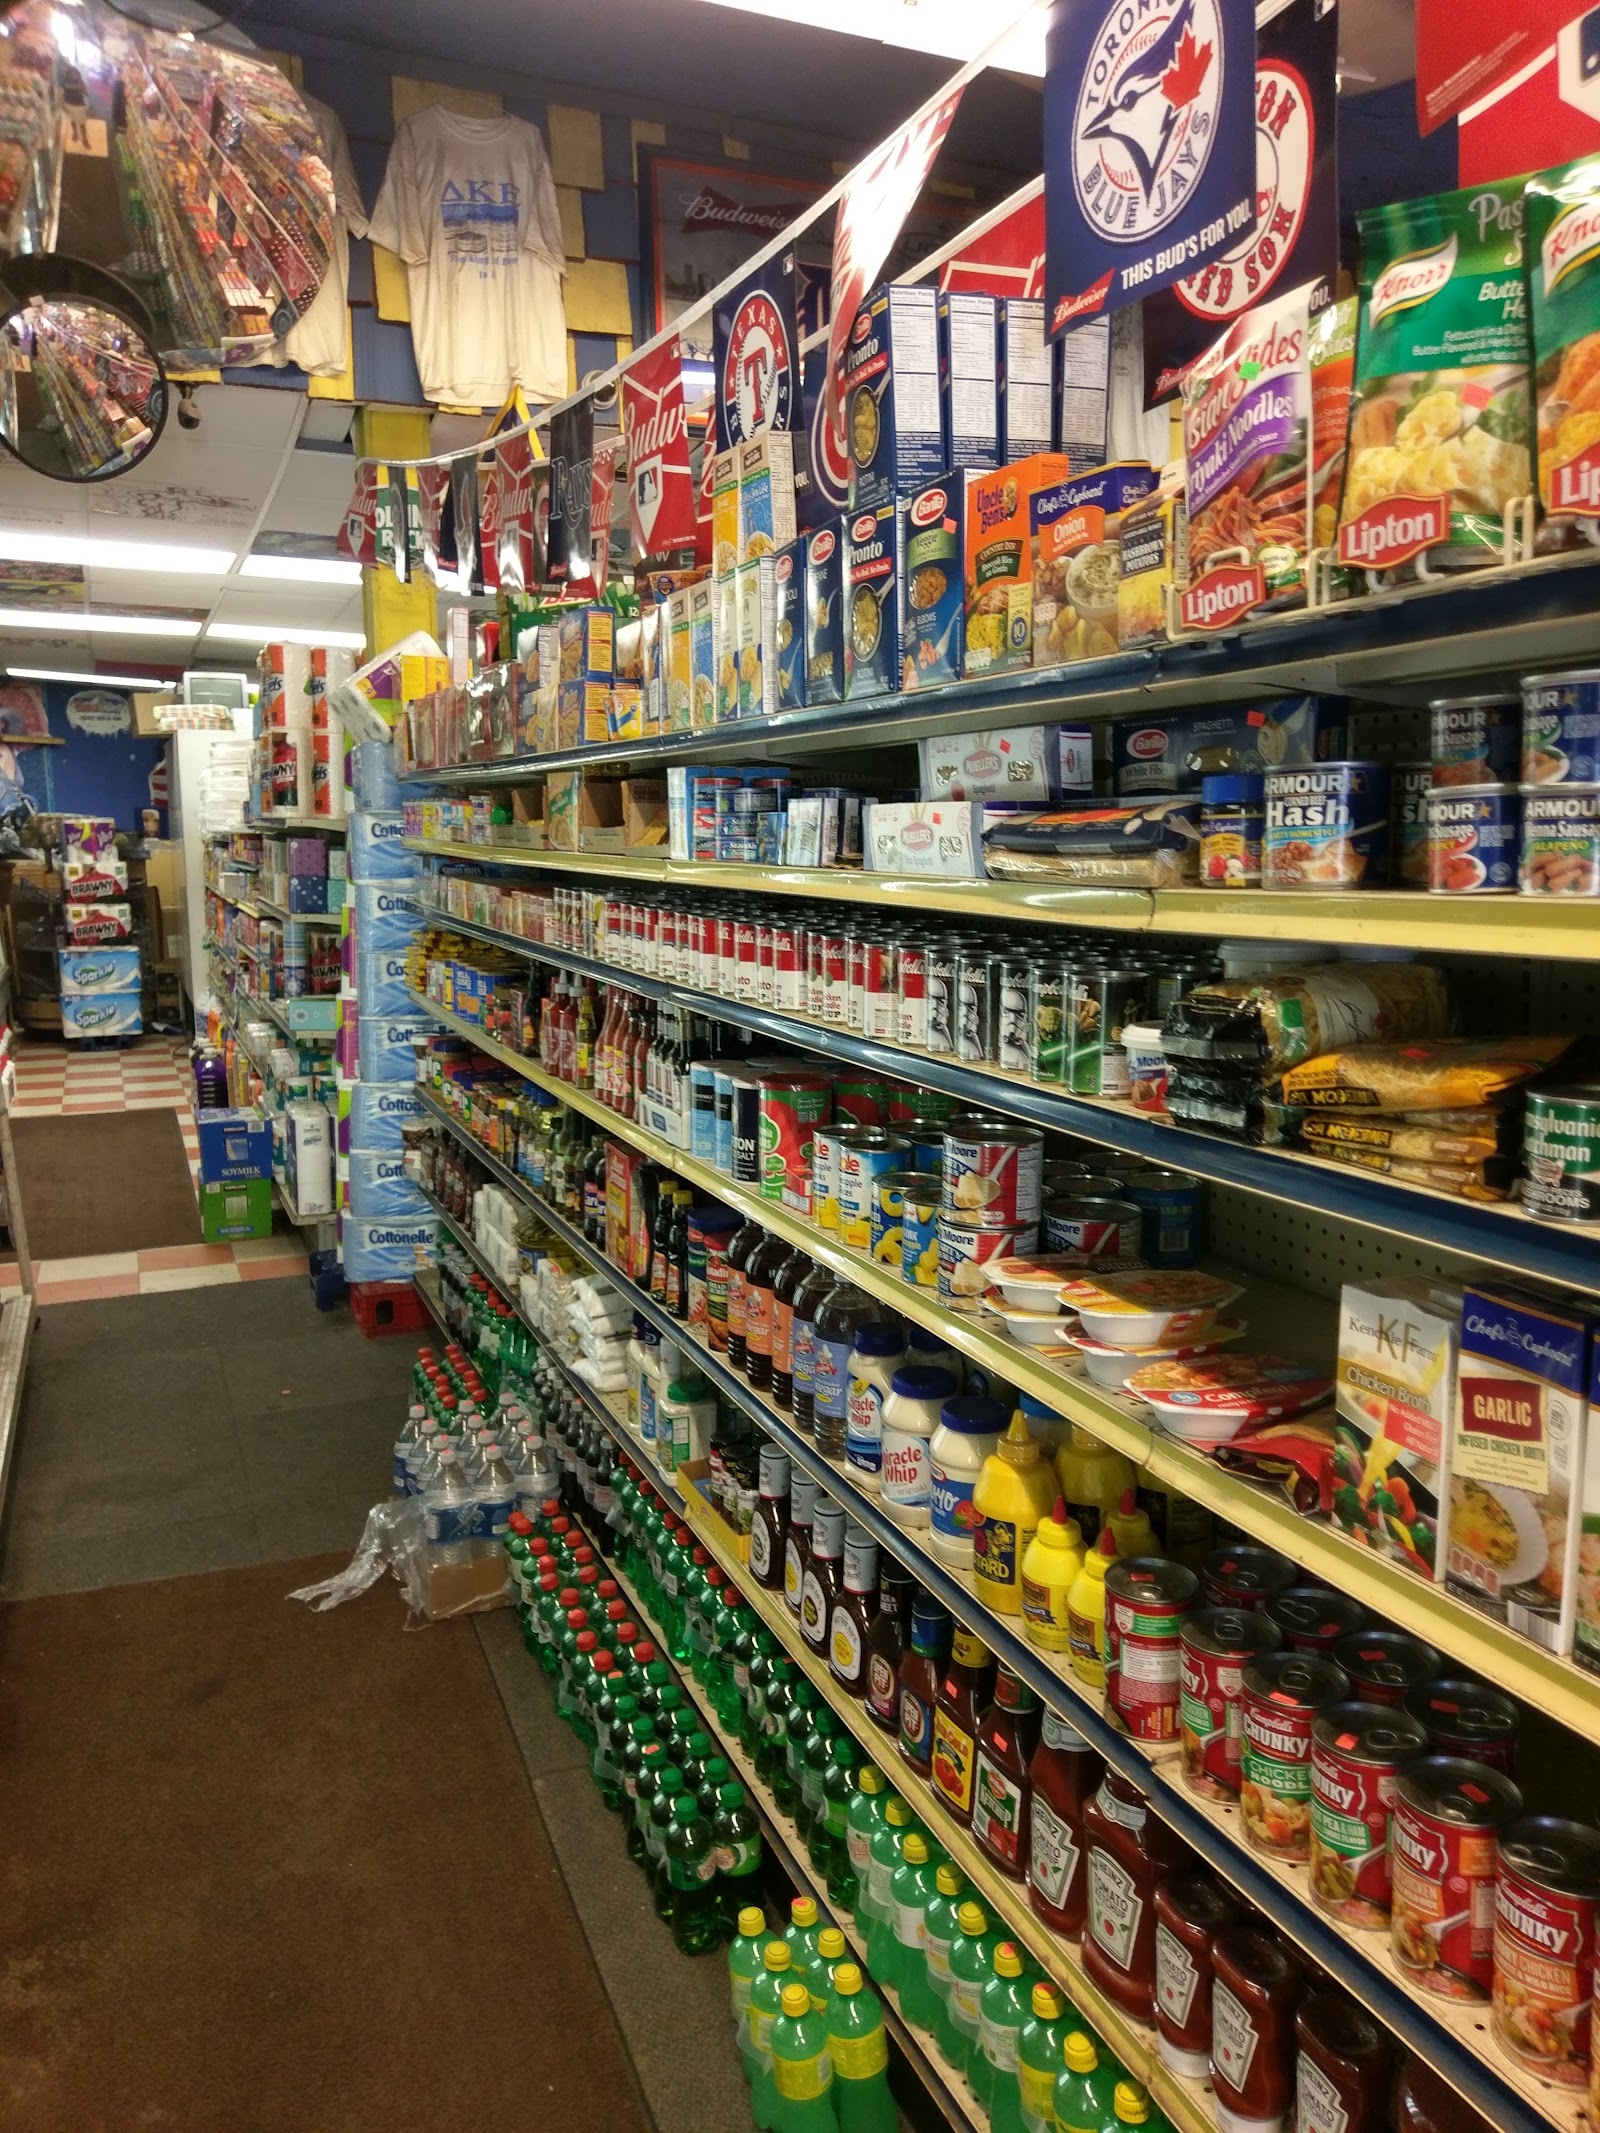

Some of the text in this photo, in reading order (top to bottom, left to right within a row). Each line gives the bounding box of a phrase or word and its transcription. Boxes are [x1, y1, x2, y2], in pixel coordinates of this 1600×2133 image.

[1082, 110, 1210, 230] BLUE JAYS
[1120, 199, 1253, 291] THIS BUD'S FOR YOU.
[1245, 202, 1296, 294] SOX
[1377, 264, 1448, 308] Knorr
[1053, 286, 1109, 323] Budweiser
[731, 304, 776, 359] TEXAS
[1227, 390, 1294, 447] Noodles
[977, 483, 1003, 513] Uncle
[980, 505, 1007, 535] Ben's
[1053, 516, 1087, 543] Onion
[1345, 511, 1436, 562] Lipton
[848, 541, 884, 565] Pronto
[1186, 578, 1255, 623] Lipton
[1265, 798, 1349, 828] Hash
[1525, 799, 1600, 818] ARMOU
[71, 880, 114, 897] BRAWNY
[75, 922, 117, 937] BRAWNY
[73, 961, 117, 983] Sparkle
[76, 1005, 117, 1028] Sparkle
[221, 1166, 261, 1177] SOYMILK
[368, 1229, 434, 1245] Cottonelle
[1346, 1365, 1397, 1397] Chicken
[1473, 1394, 1533, 1428] GARLIC
[1245, 1713, 1310, 1758] CHUNKY
[1250, 1760, 1312, 1782] CHICKE
[1250, 1772, 1310, 1791] NOODL
[1099, 1859, 1124, 1889] HEINZ
